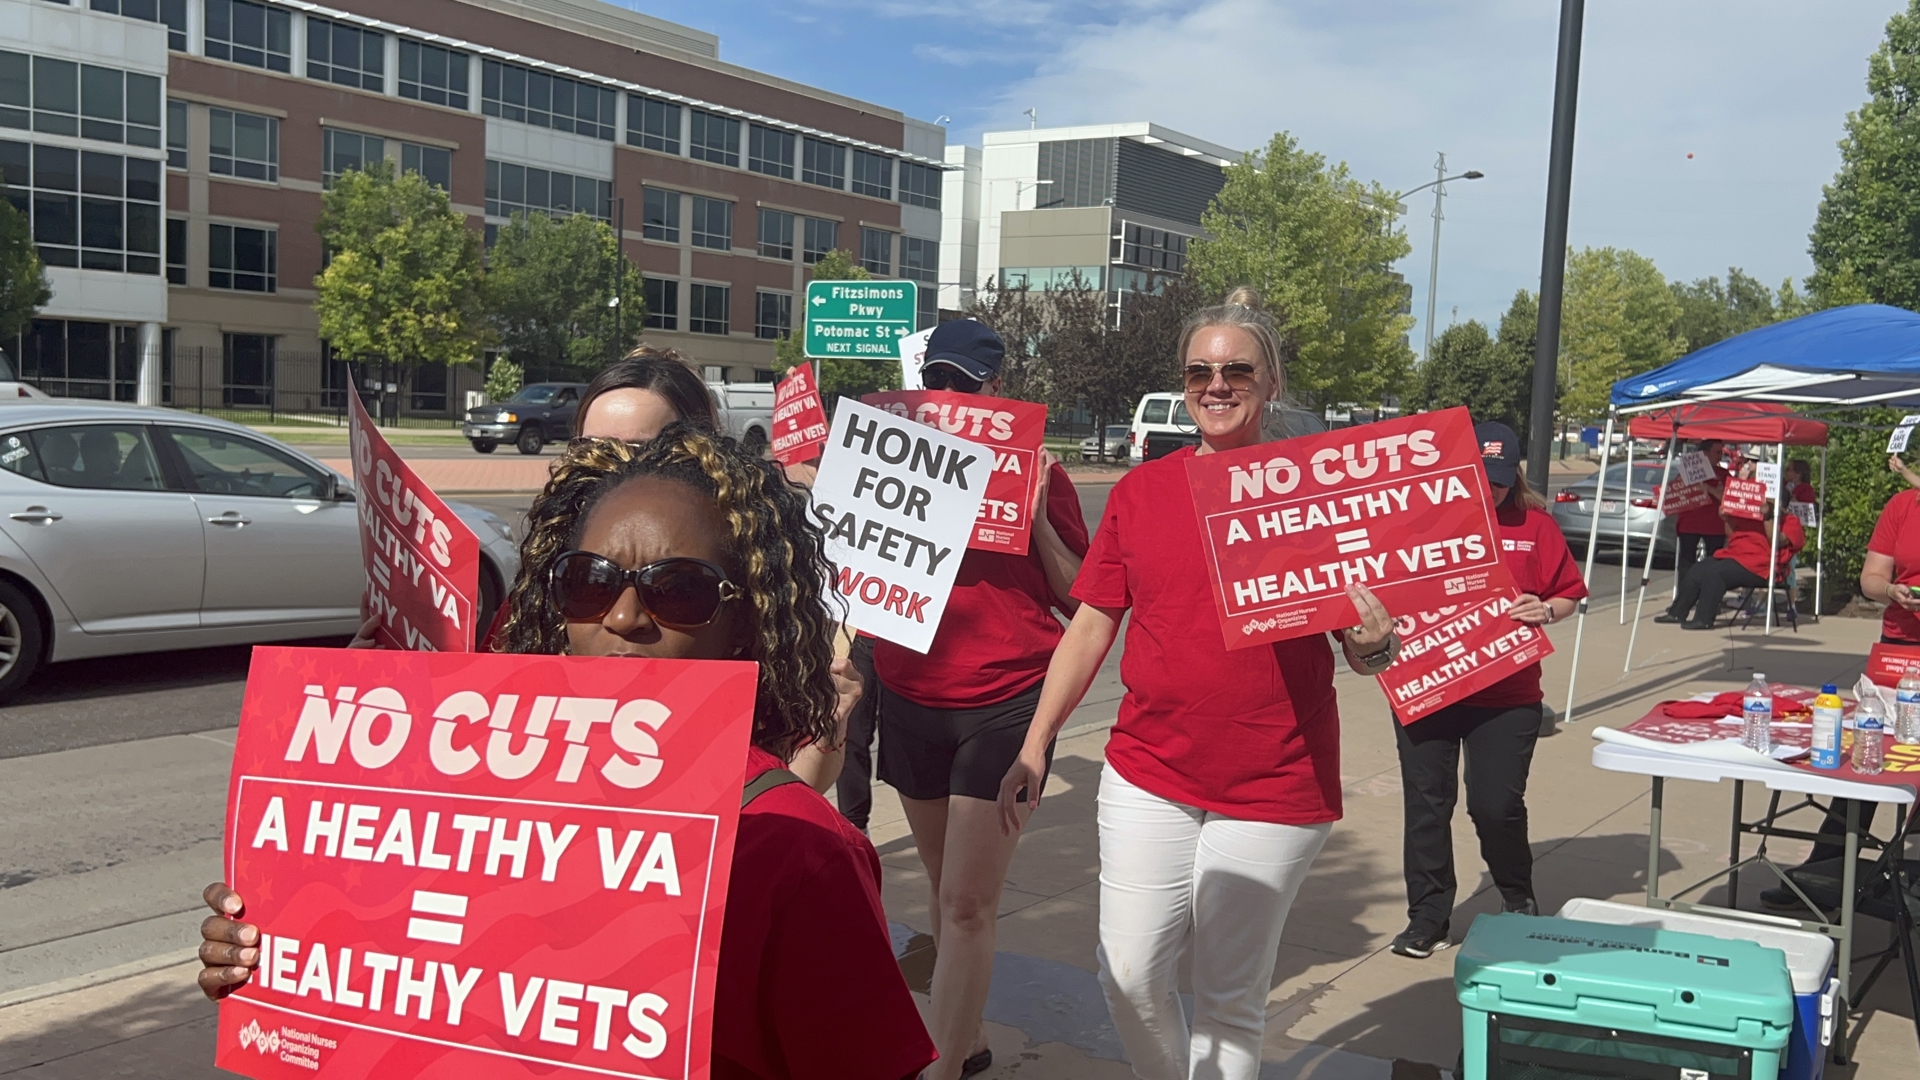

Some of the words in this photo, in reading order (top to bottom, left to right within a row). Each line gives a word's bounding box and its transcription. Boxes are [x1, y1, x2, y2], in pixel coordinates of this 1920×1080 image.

[831, 286, 904, 300] Fitzsimons
[850, 303, 884, 319] Pkwy
[814, 324, 870, 338] Potomac
[876, 325, 890, 338] St
[826, 343, 851, 353] NEXT
[856, 343, 891, 354] SIGNAL
[778, 399, 804, 420] HEALTHY
[804, 395, 817, 410] VA
[916, 402, 1015, 441] CUTS
[774, 430, 804, 451] HEALTHY
[804, 422, 826, 440] VETS
[842, 413, 977, 490] HONK
[992, 453, 1022, 475] VA
[1228, 457, 1300, 503] NO
[1310, 430, 1441, 486] CUTS
[853, 467, 931, 522] FOR
[1730, 480, 1740, 489] NO
[1741, 482, 1760, 493] CUTS
[376, 458, 452, 568] CUTS
[977, 498, 1018, 522] ETS
[1226, 519, 1251, 545] A
[1257, 485, 1411, 538] HEALTHY
[1419, 476, 1471, 507] VA
[815, 503, 951, 576] SAFETY
[1233, 553, 1388, 607] HEALTHY
[1400, 534, 1486, 573] VETS
[1466, 571, 1489, 580] National
[1467, 578, 1486, 586] Nurses
[829, 562, 931, 623] WORK
[1467, 583, 1487, 591] United
[429, 574, 461, 631] VA
[1275, 610, 1299, 619] National
[1299, 607, 1317, 615] Nurses
[1277, 614, 1307, 624] Organizing
[1278, 620, 1308, 629] Committee
[1399, 610, 1482, 662] HEALTHY
[1483, 597, 1513, 618] VA
[1395, 651, 1482, 702] HEALTHY
[1480, 626, 1533, 659] VETS
[285, 685, 412, 769] NO
[428, 690, 673, 789] CUTS
[252, 796, 288, 851] A
[303, 800, 581, 882] HEALTHY
[597, 826, 681, 896] VA
[1526, 934, 1594, 947] Labor
[1630, 945, 1690, 958] Bank
[499, 971, 669, 1060] VETS
[281, 1026, 311, 1042] National
[311, 1033, 337, 1049] Nurses
[281, 1038, 319, 1059] Organizing
[280, 1051, 319, 1070] Committee
